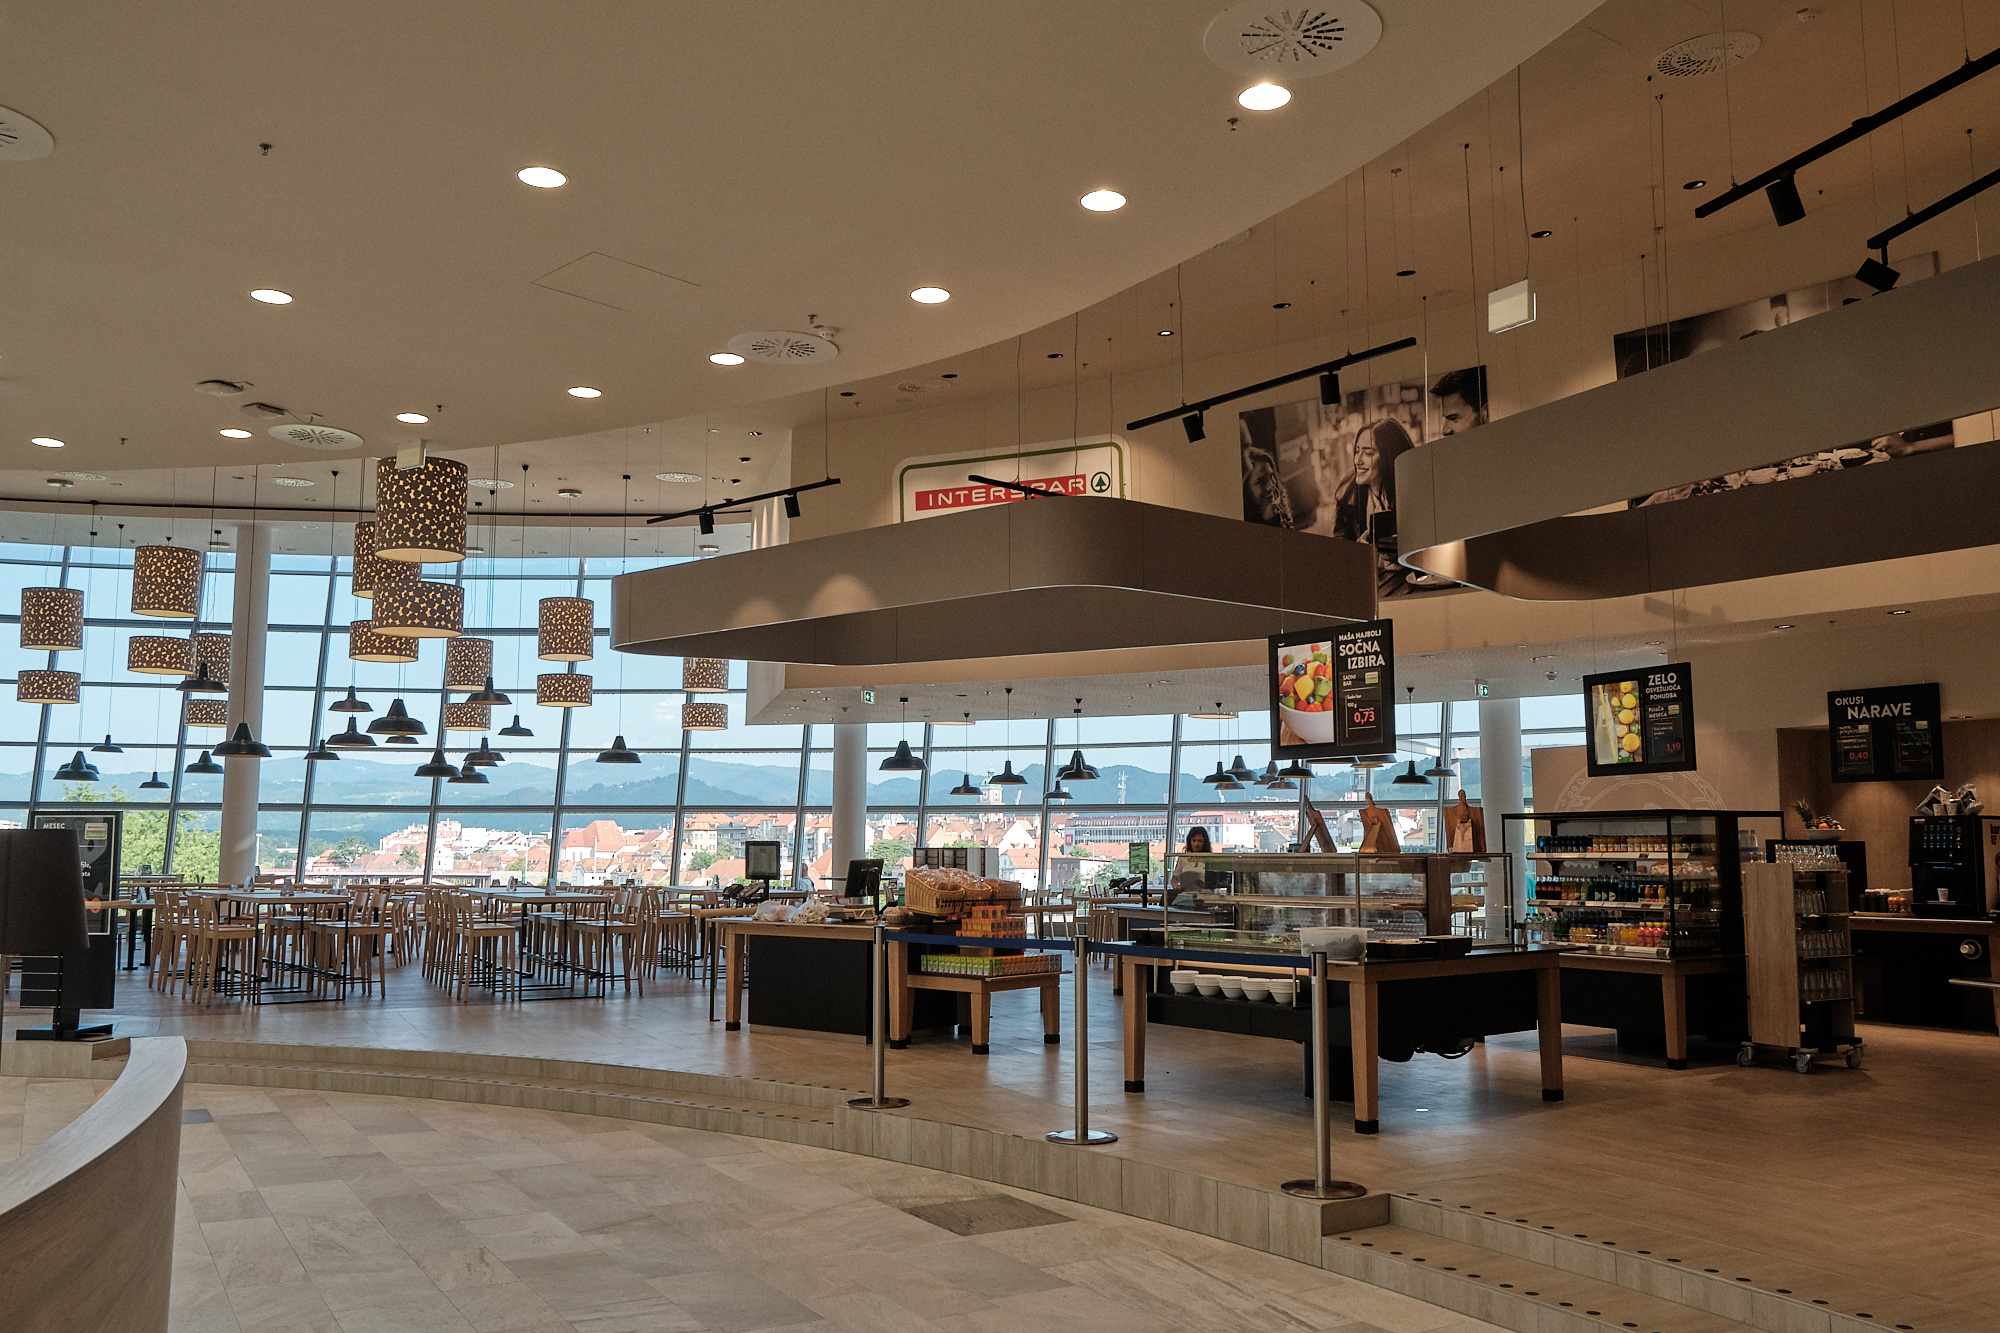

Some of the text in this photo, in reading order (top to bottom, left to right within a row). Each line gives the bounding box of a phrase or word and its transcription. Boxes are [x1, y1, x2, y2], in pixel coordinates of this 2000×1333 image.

[929, 478, 1084, 507] INTERSPAR
[1339, 632, 1355, 641] NAŠA
[1339, 639, 1381, 657] SOČNA
[1347, 654, 1386, 670] IZBIRA
[1648, 672, 1677, 686] ZELO
[1650, 692, 1678, 700] PONUDBA
[1835, 696, 1864, 706] OKUSI
[1847, 702, 1912, 719] NARAVE
[1353, 711, 1375, 725] 0,73
[1666, 742, 1681, 752] 1,19
[1849, 751, 1869, 760] 0,40
